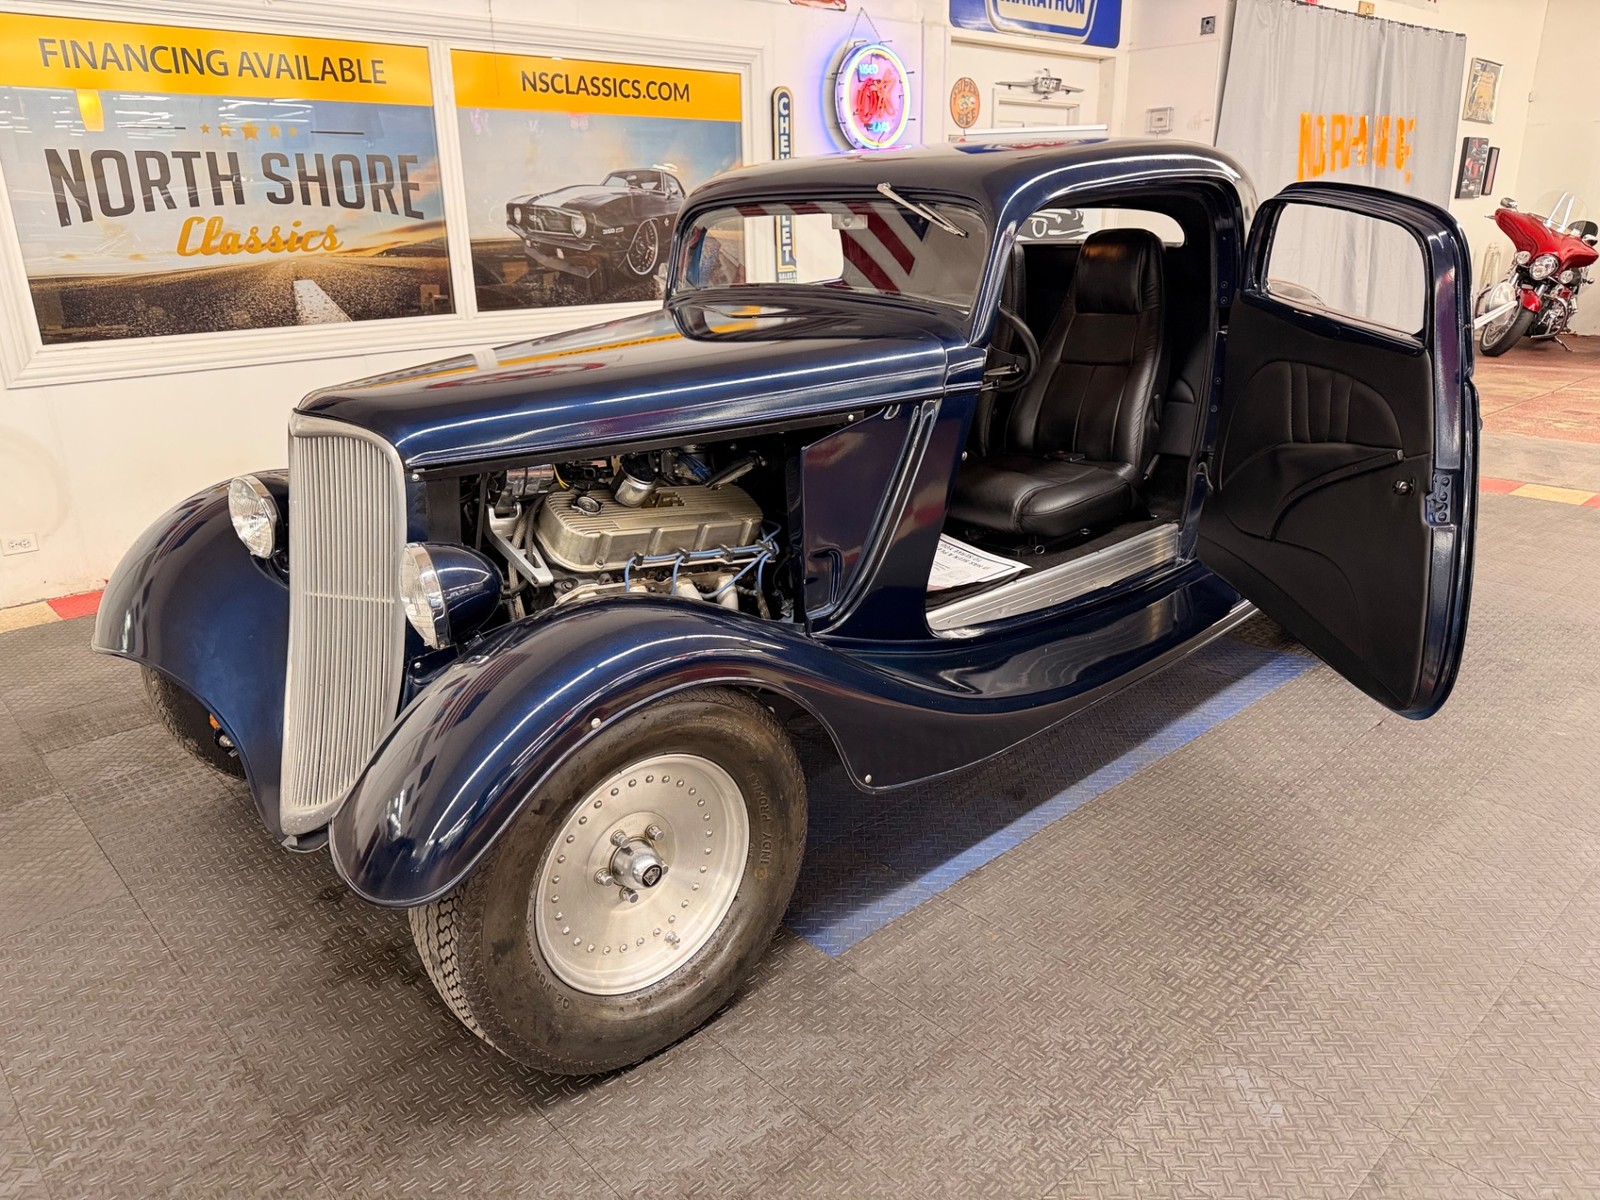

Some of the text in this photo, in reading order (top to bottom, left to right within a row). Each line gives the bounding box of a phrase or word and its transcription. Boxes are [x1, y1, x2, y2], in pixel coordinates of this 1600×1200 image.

[38, 38, 387, 84] FINANCING AVAILABLE
[521, 70, 690, 103] NSCLASSICS.COM
[957, 108, 976, 126] BEE
[44, 148, 425, 227] NORTH SHORE
[176, 216, 344, 257] Classics
[760, 832, 773, 865] INDY
